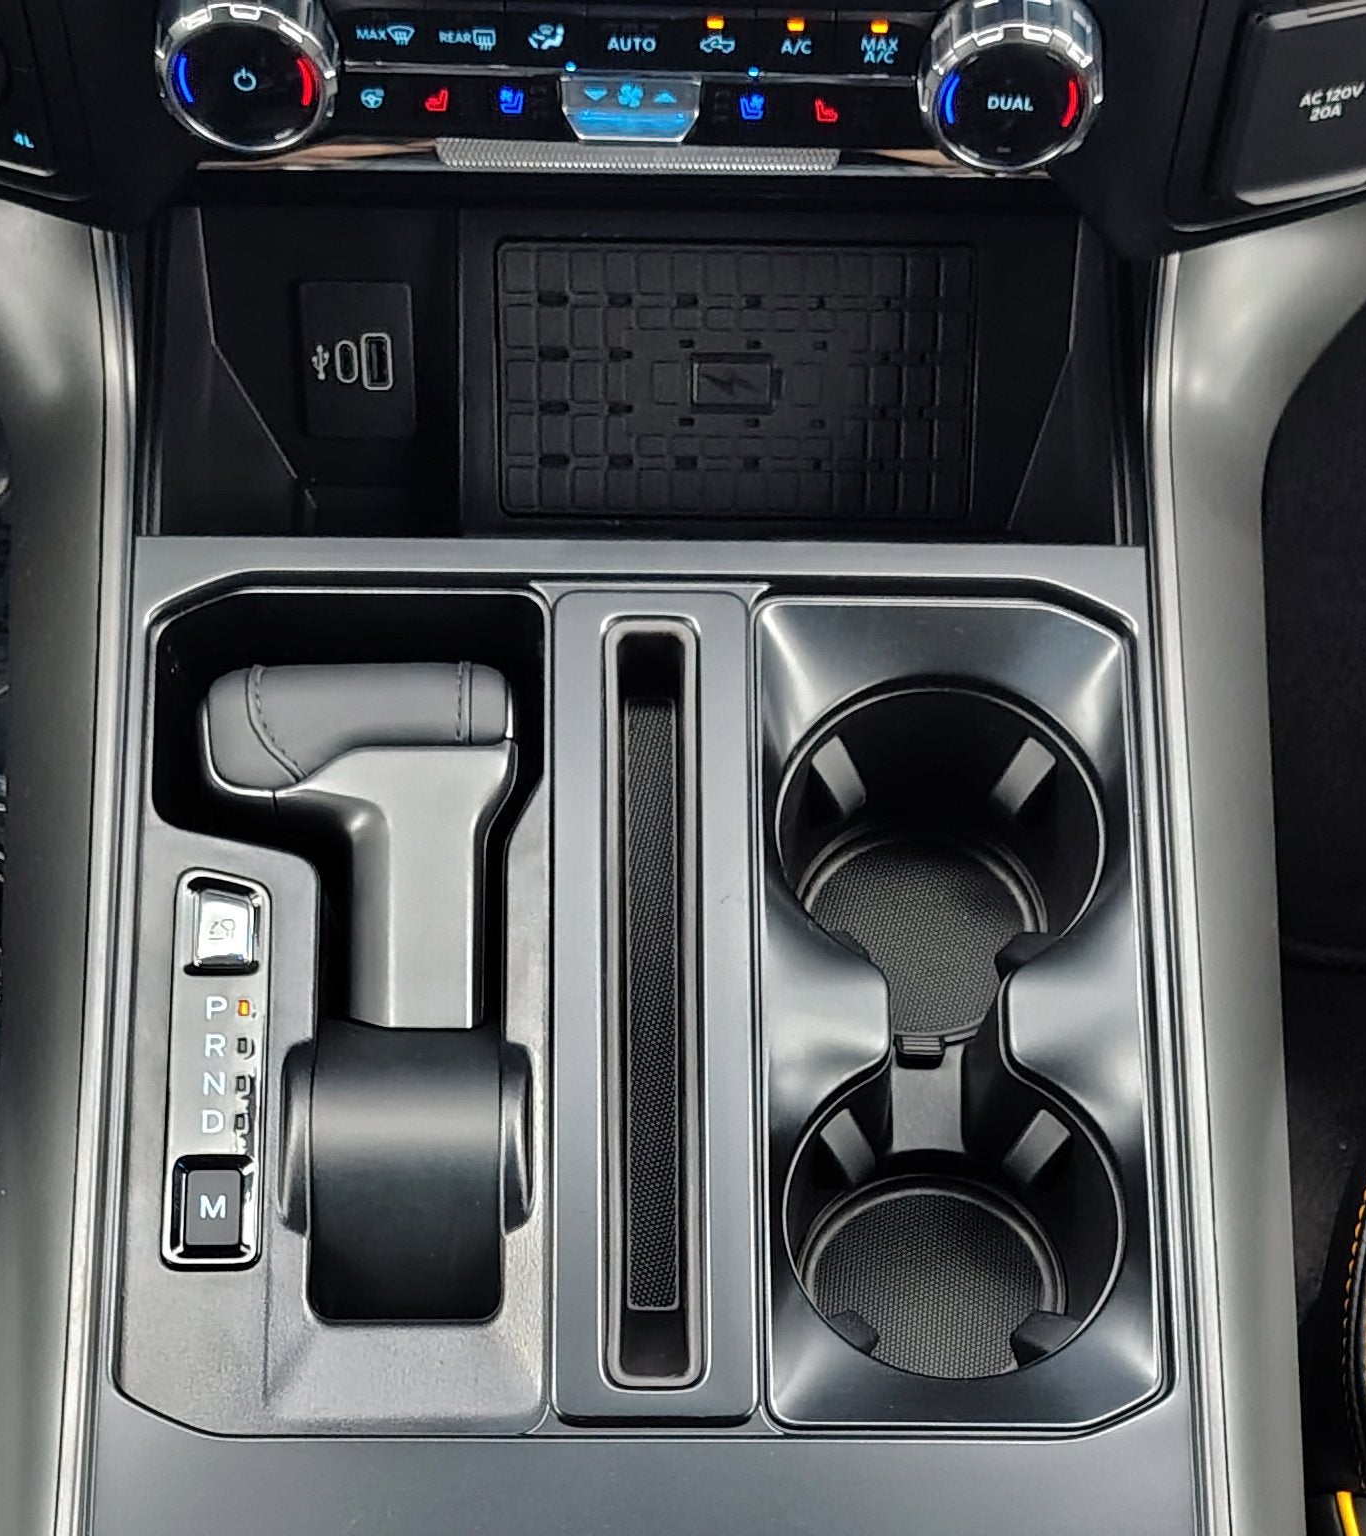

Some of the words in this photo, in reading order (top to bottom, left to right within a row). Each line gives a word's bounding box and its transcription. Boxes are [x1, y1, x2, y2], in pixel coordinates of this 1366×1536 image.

[356, 28, 386, 42] MAX
[439, 31, 471, 44] REAR
[607, 36, 656, 53] AUTO
[780, 38, 812, 55] A/C
[861, 37, 899, 52] MAX
[864, 49, 895, 65] A/C
[986, 94, 1034, 113] DUAL
[1299, 90, 1323, 108] AC
[1326, 81, 1365, 101] 120V
[1309, 103, 1342, 121] 20A
[205, 996, 228, 1021] P
[204, 1033, 227, 1058] R
[202, 1071, 226, 1096] N
[201, 1109, 224, 1135] D
[199, 1194, 227, 1220] M
